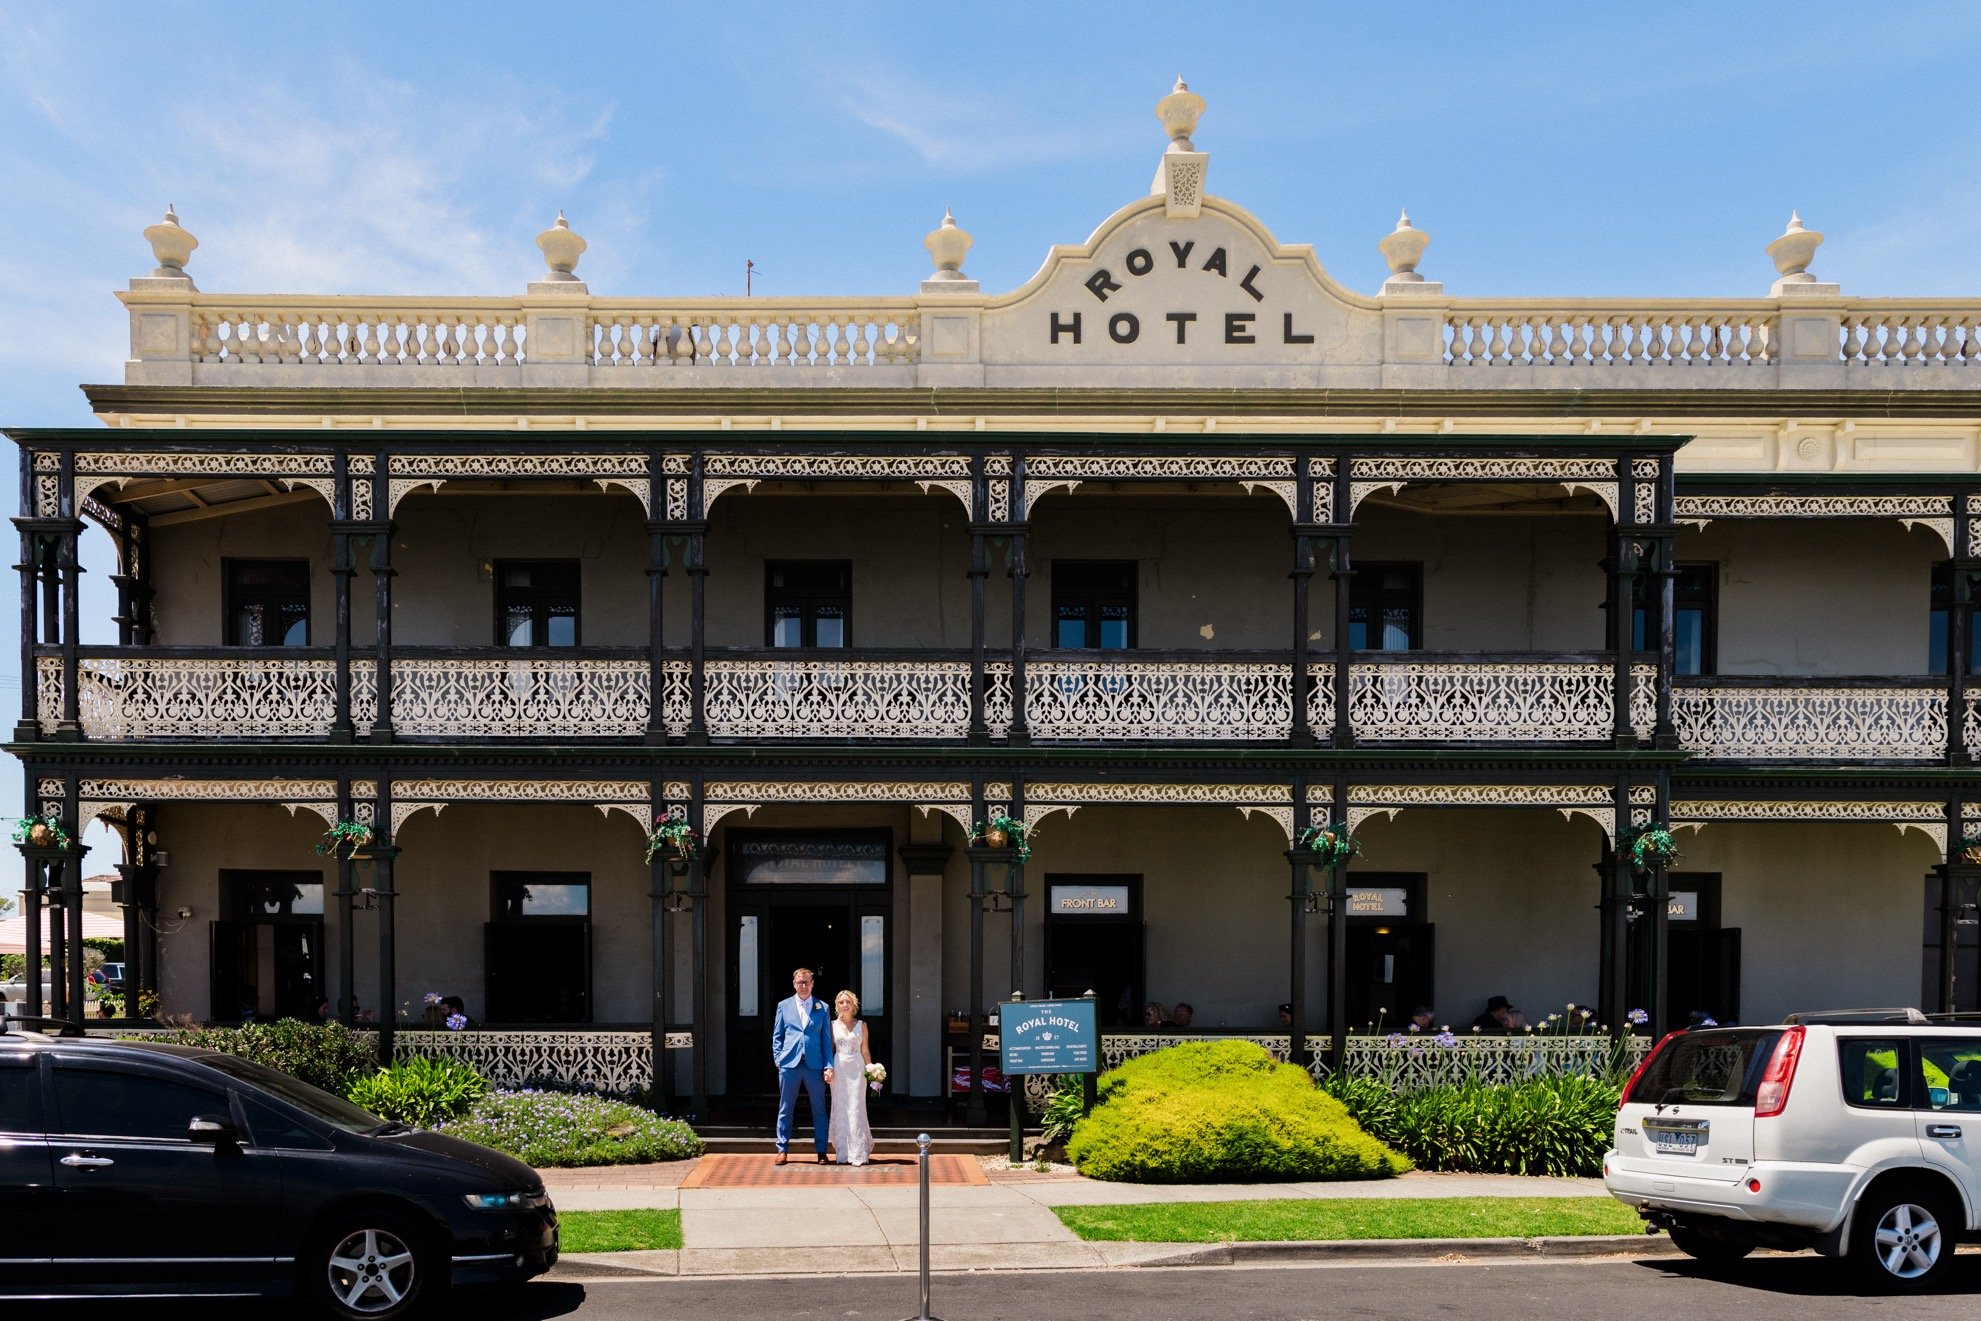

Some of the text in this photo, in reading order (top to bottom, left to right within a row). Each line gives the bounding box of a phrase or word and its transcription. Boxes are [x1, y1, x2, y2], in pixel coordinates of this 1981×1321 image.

[1085, 241, 1264, 303] ROYAL
[1050, 312, 1315, 345] HOTEL
[1061, 898, 1117, 908] FRONT BAR
[1352, 892, 1384, 902] ROYAL
[1352, 902, 1384, 911] HOTEL
[1015, 1016, 1080, 1035] ROYAL HOTEL
[1679, 1135, 1696, 1149] 057
